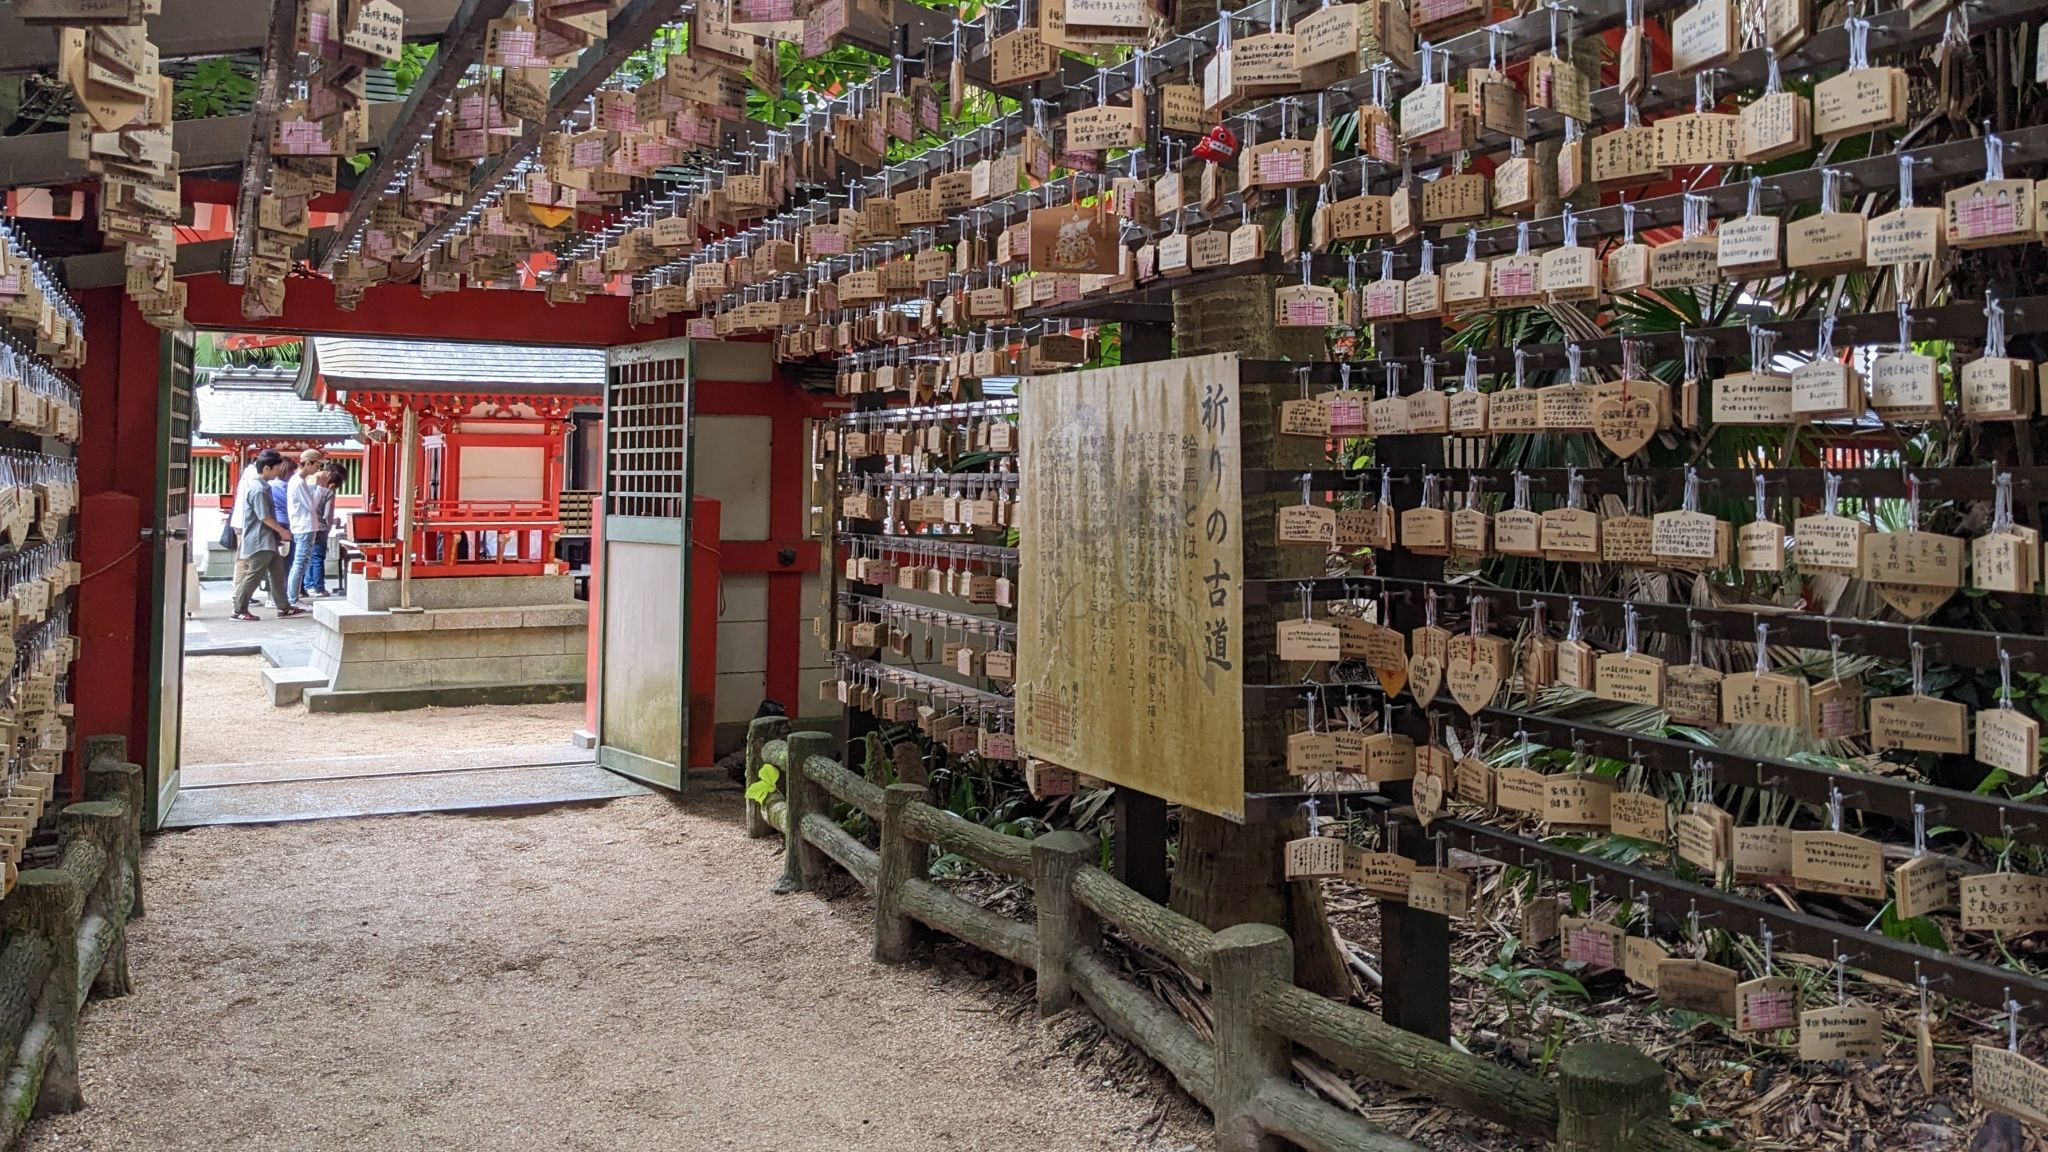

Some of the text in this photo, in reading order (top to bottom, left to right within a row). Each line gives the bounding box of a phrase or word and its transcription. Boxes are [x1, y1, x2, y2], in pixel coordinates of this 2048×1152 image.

[1201, 383, 1233, 672] 祈りの古道
